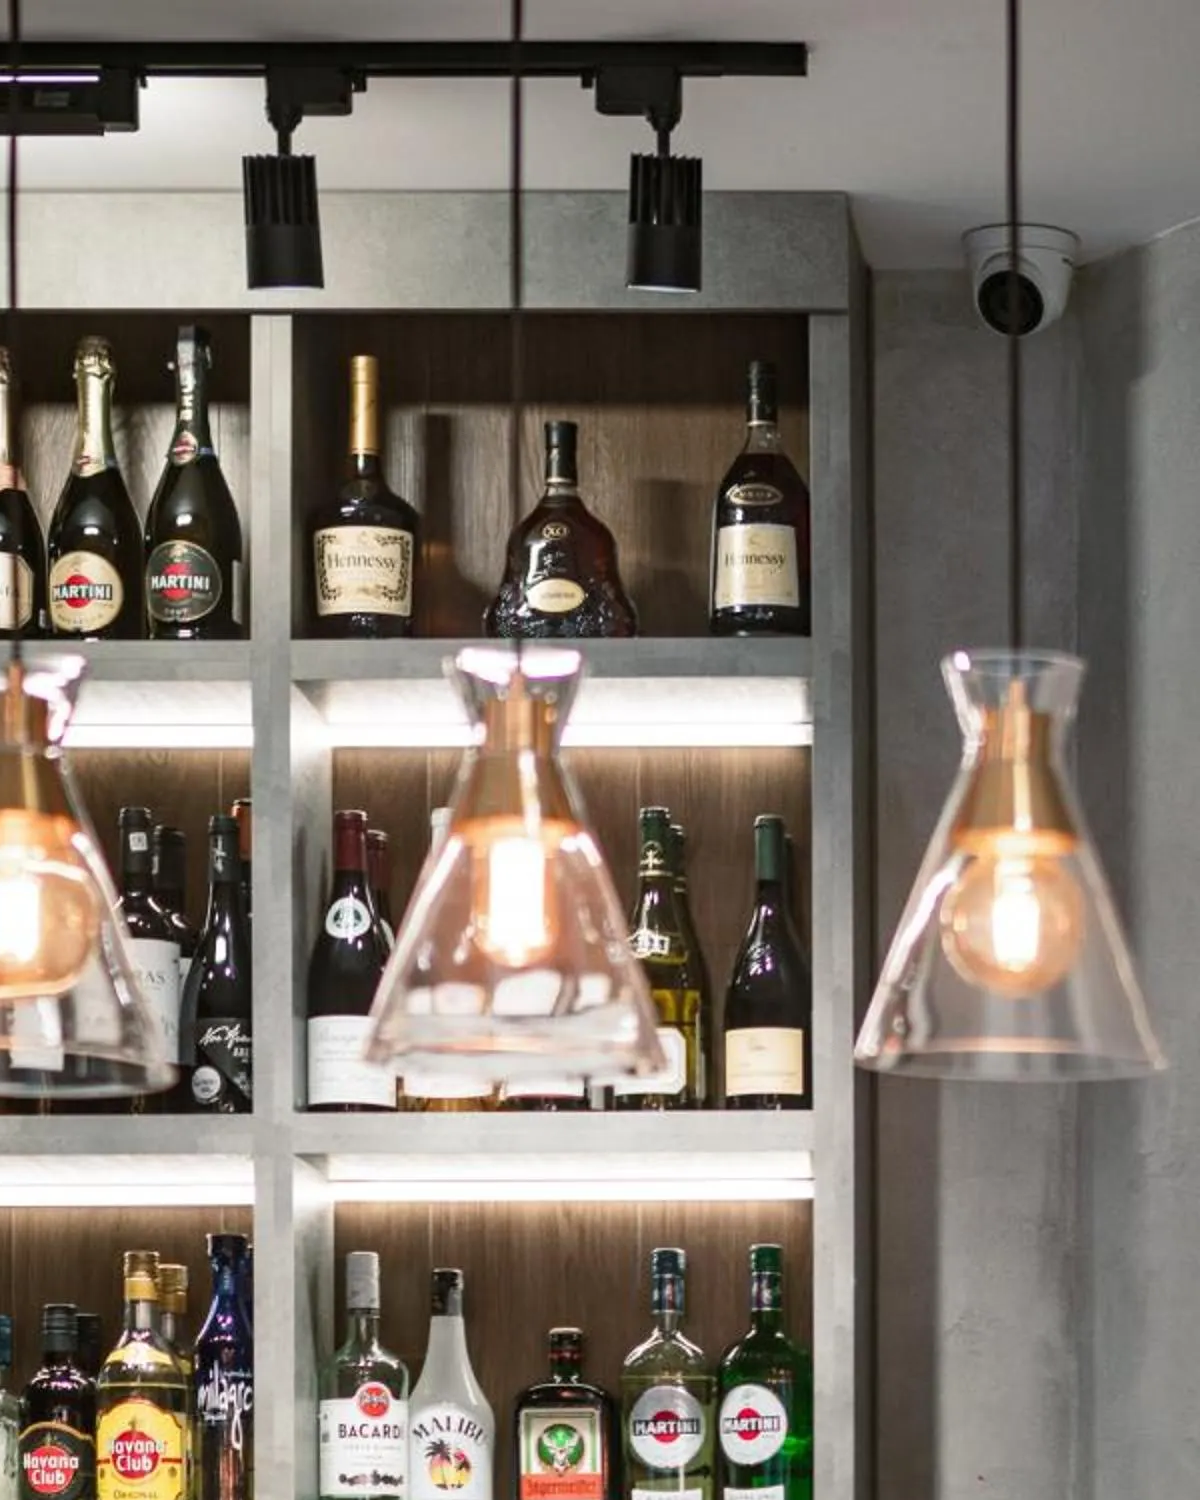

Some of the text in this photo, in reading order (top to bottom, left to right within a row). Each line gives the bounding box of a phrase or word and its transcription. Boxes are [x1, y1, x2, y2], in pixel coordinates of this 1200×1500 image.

[327, 553, 396, 572] Hennessy
[151, 574, 211, 591] MARTINI
[52, 584, 112, 601] MARTINI
[412, 1415, 490, 1447] MALIBU
[633, 1420, 701, 1435] MARTINI
[22, 1452, 80, 1470] Havana
[116, 1455, 153, 1472] Club
[31, 1469, 66, 1486] Club
